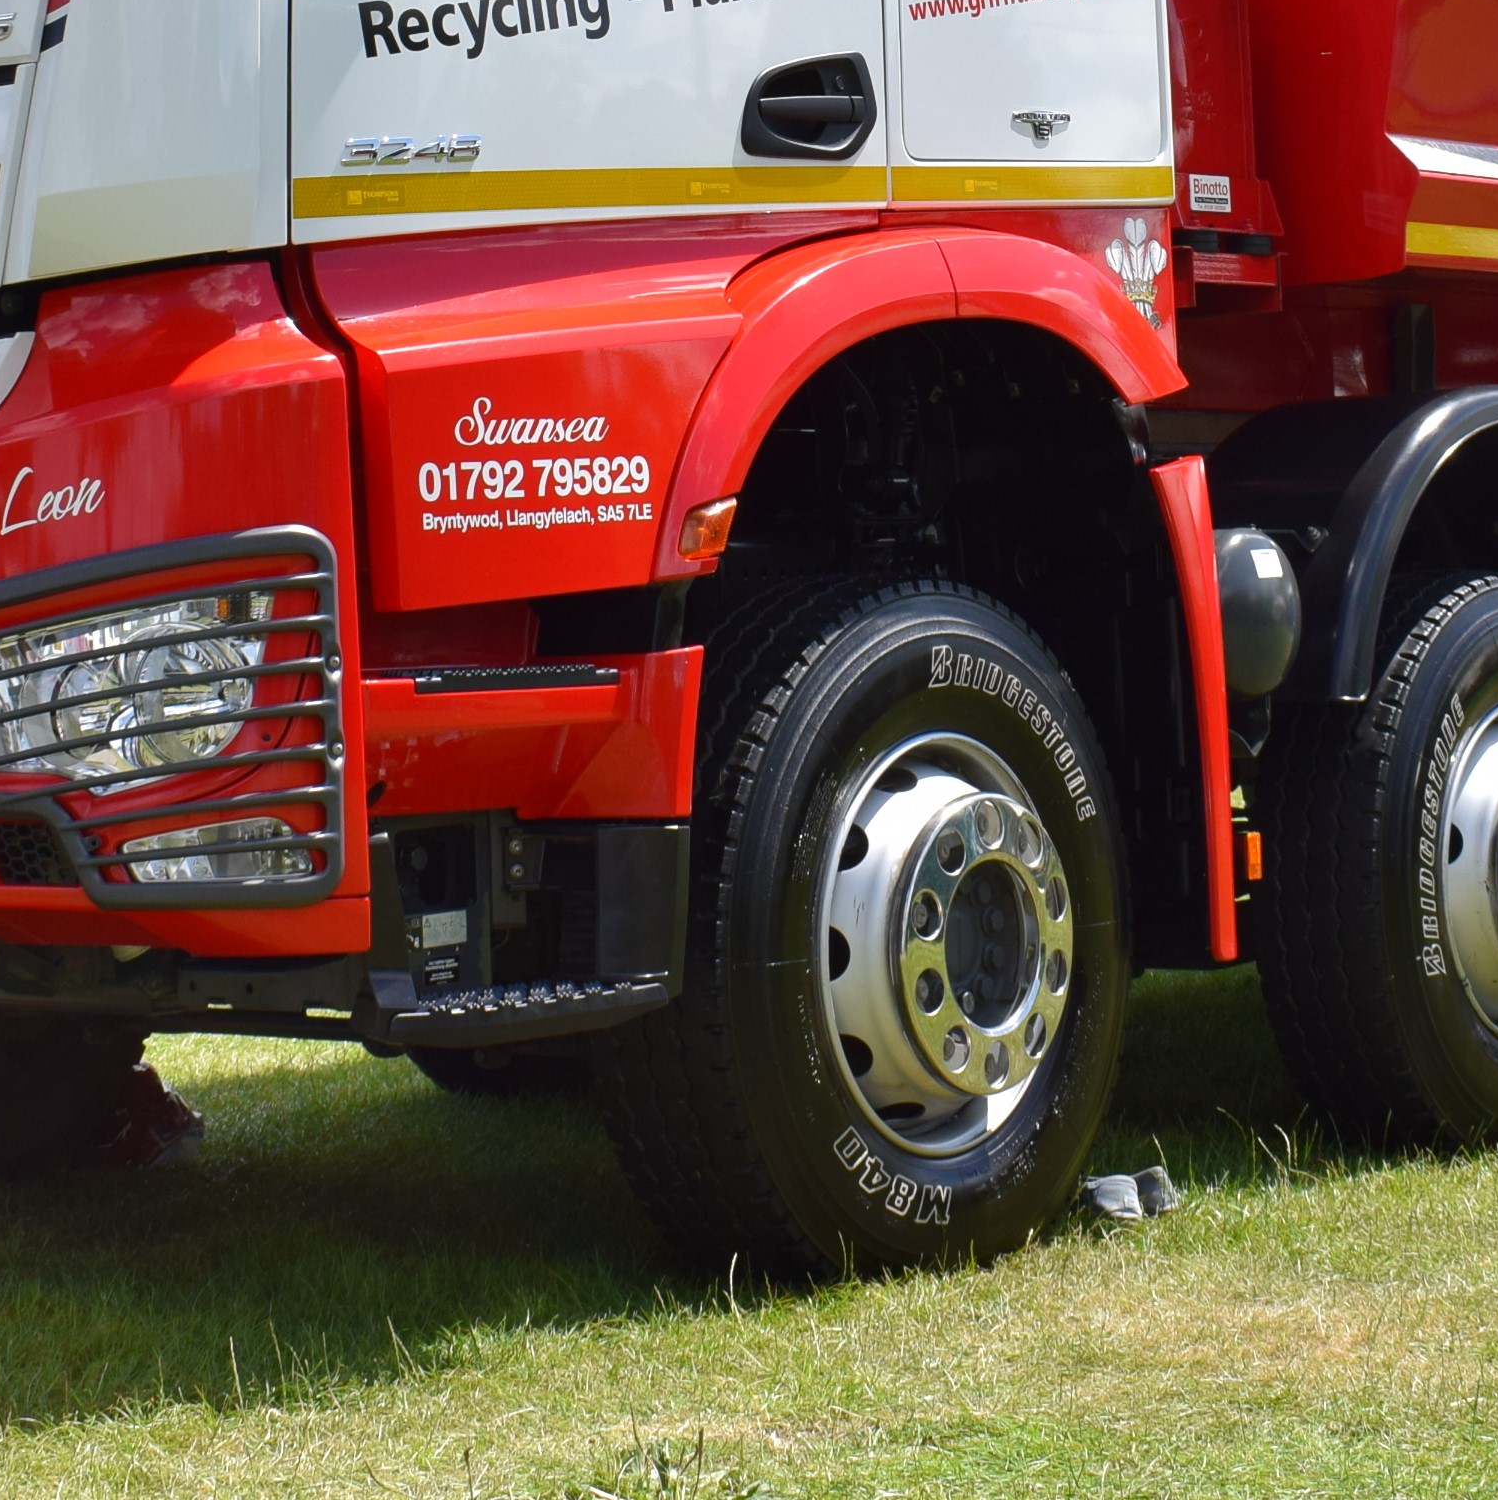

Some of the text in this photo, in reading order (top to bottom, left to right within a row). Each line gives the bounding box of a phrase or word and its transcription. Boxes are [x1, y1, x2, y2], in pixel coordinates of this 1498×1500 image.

[1193, 178, 1228, 195] Binotto
[455, 397, 609, 446] Swansea
[0, 465, 105, 536] Leon
[419, 456, 650, 502] 01792 795829
[423, 502, 652, 534] Bryntywod, Llangyfelach, SA5 7LE
[928, 644, 1096, 823] BRIDGESTONE
[1415, 692, 1465, 979] BRIDGESTONE
[833, 1125, 952, 1225] M840
